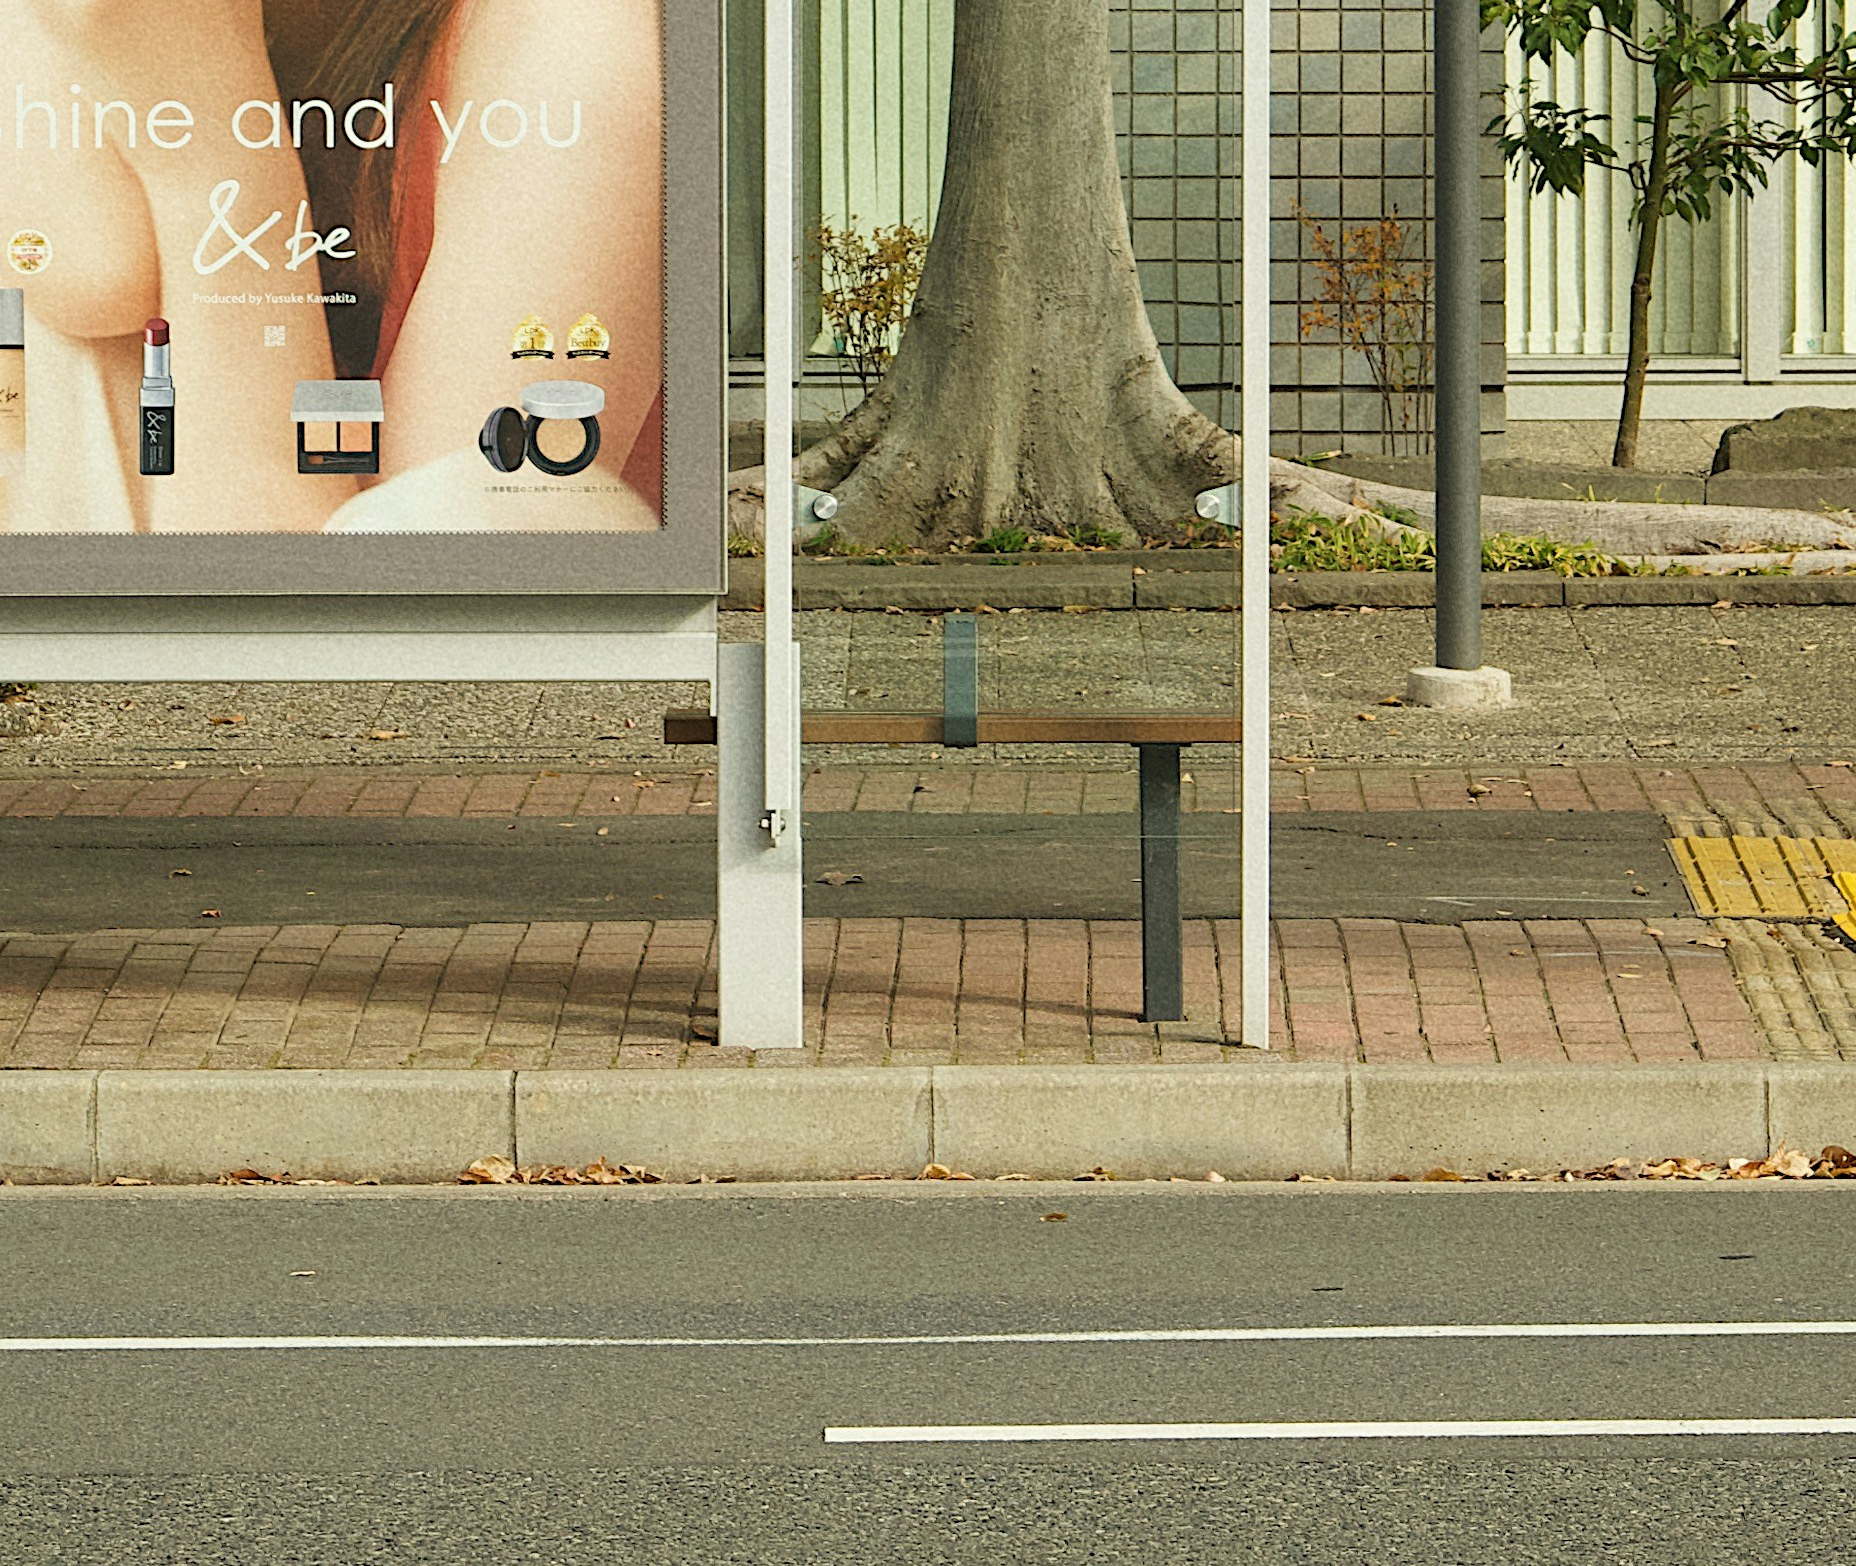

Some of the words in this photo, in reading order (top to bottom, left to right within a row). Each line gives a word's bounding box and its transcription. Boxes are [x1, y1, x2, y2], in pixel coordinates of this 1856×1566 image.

[231, 83, 397, 151] and
[429, 99, 583, 164] you
[192, 293, 246, 304] Produced
[249, 293, 262, 306] by
[265, 293, 304, 304] Yusuke
[307, 292, 357, 304] Kawakita
